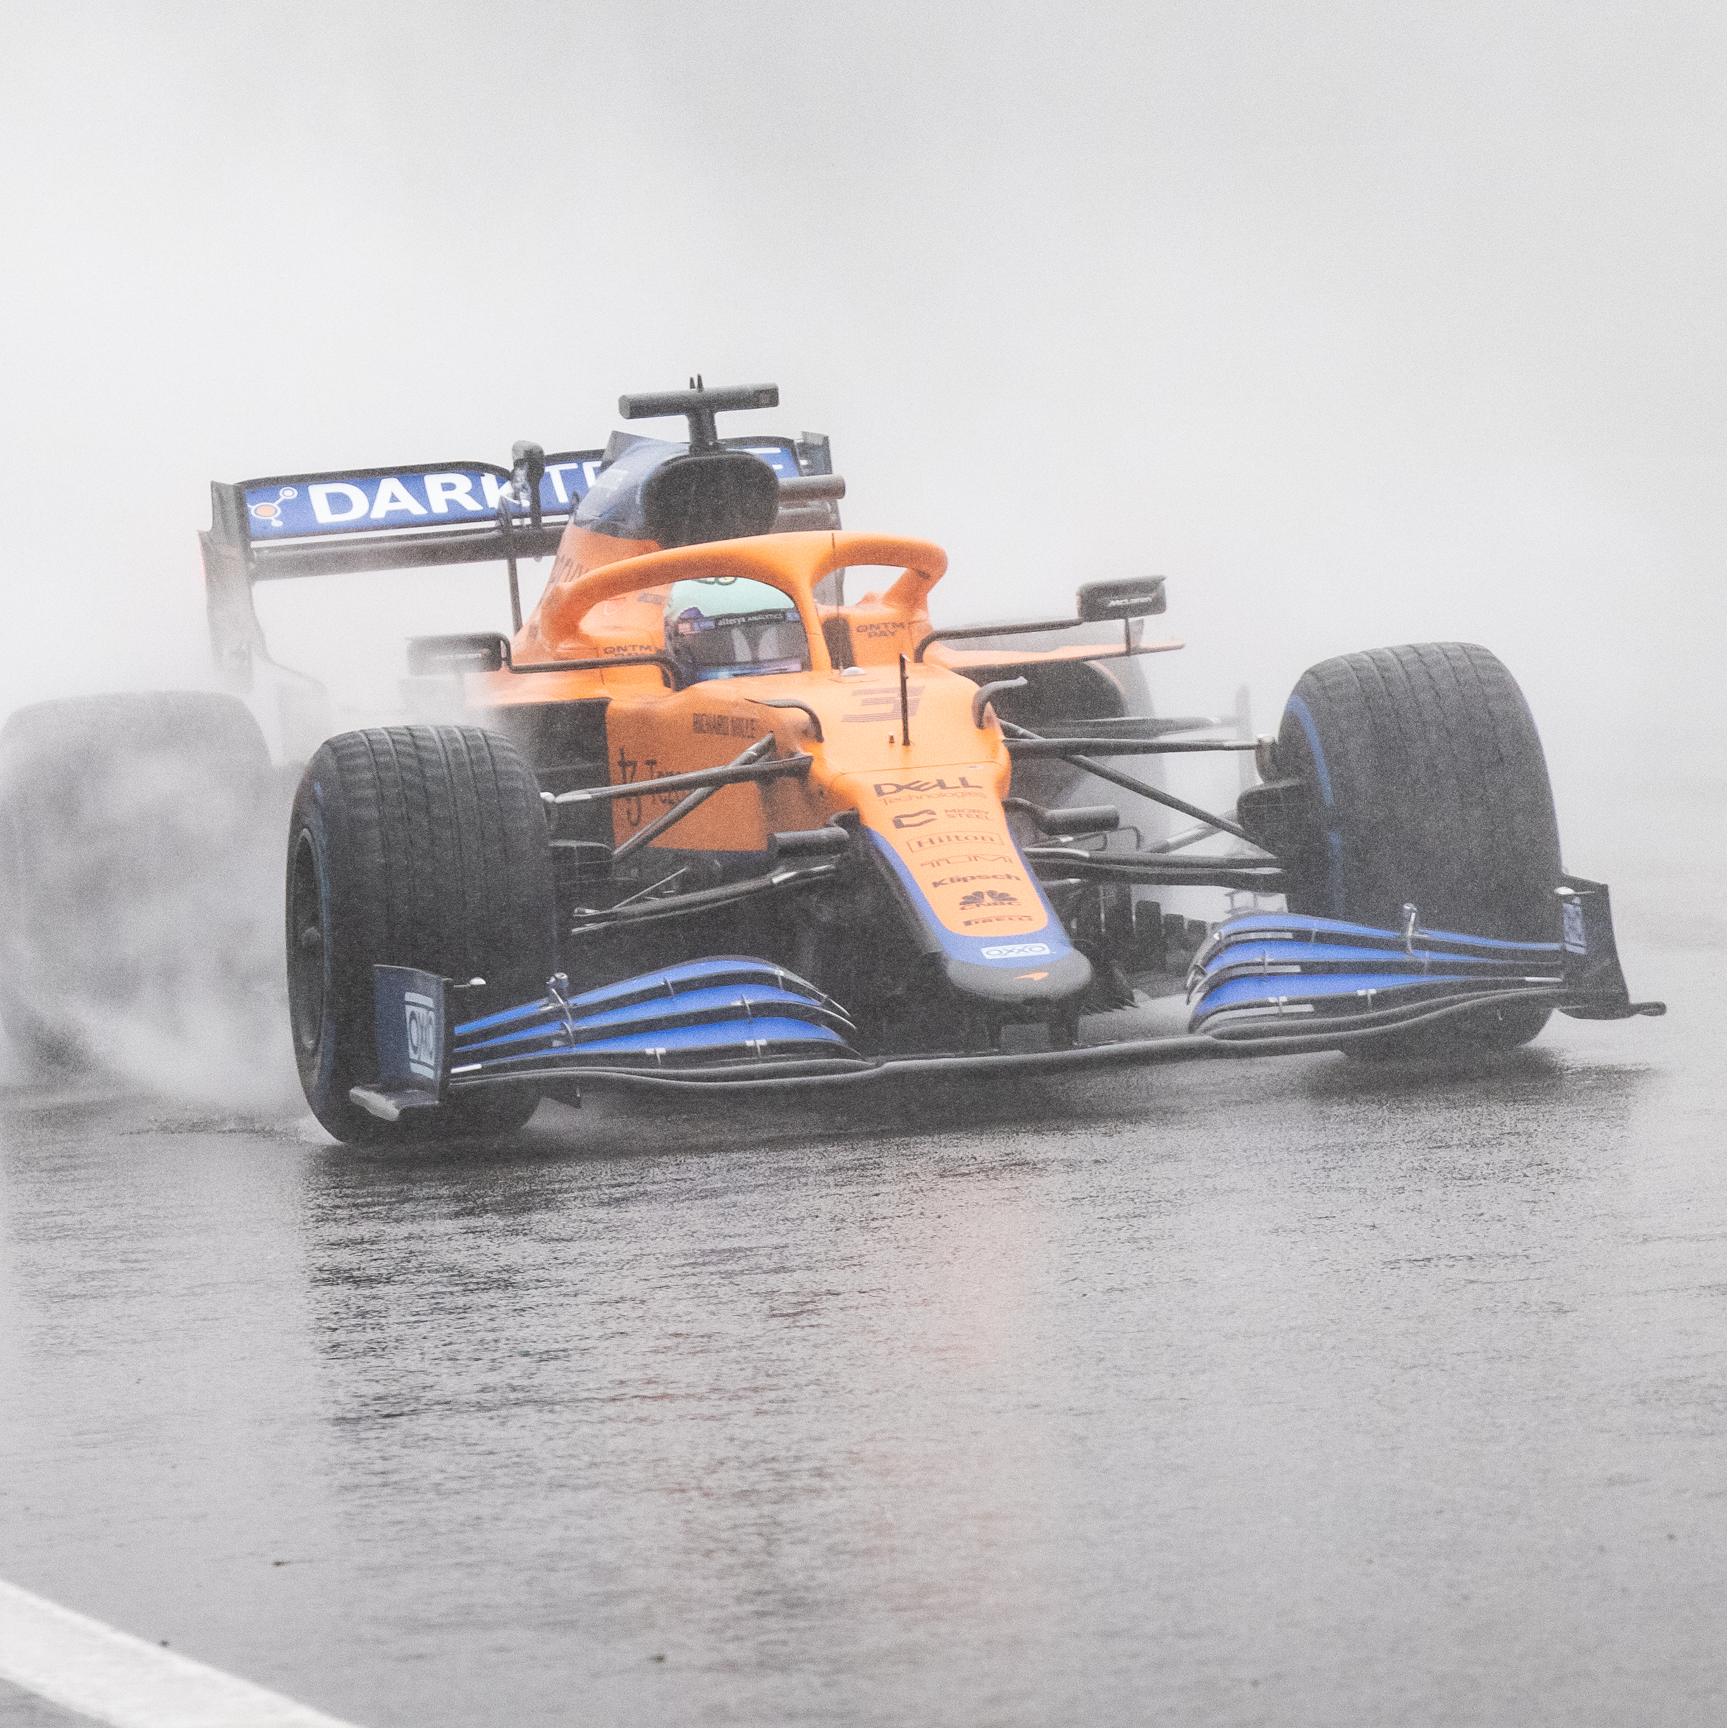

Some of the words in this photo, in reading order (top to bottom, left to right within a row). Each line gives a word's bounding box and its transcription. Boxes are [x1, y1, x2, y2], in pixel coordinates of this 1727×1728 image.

[841, 685, 926, 723] 3
[873, 776, 983, 797] DELL
[916, 834, 995, 848] Hilton
[931, 873, 1022, 888] Klipsch
[986, 945, 1046, 957] OXXO
